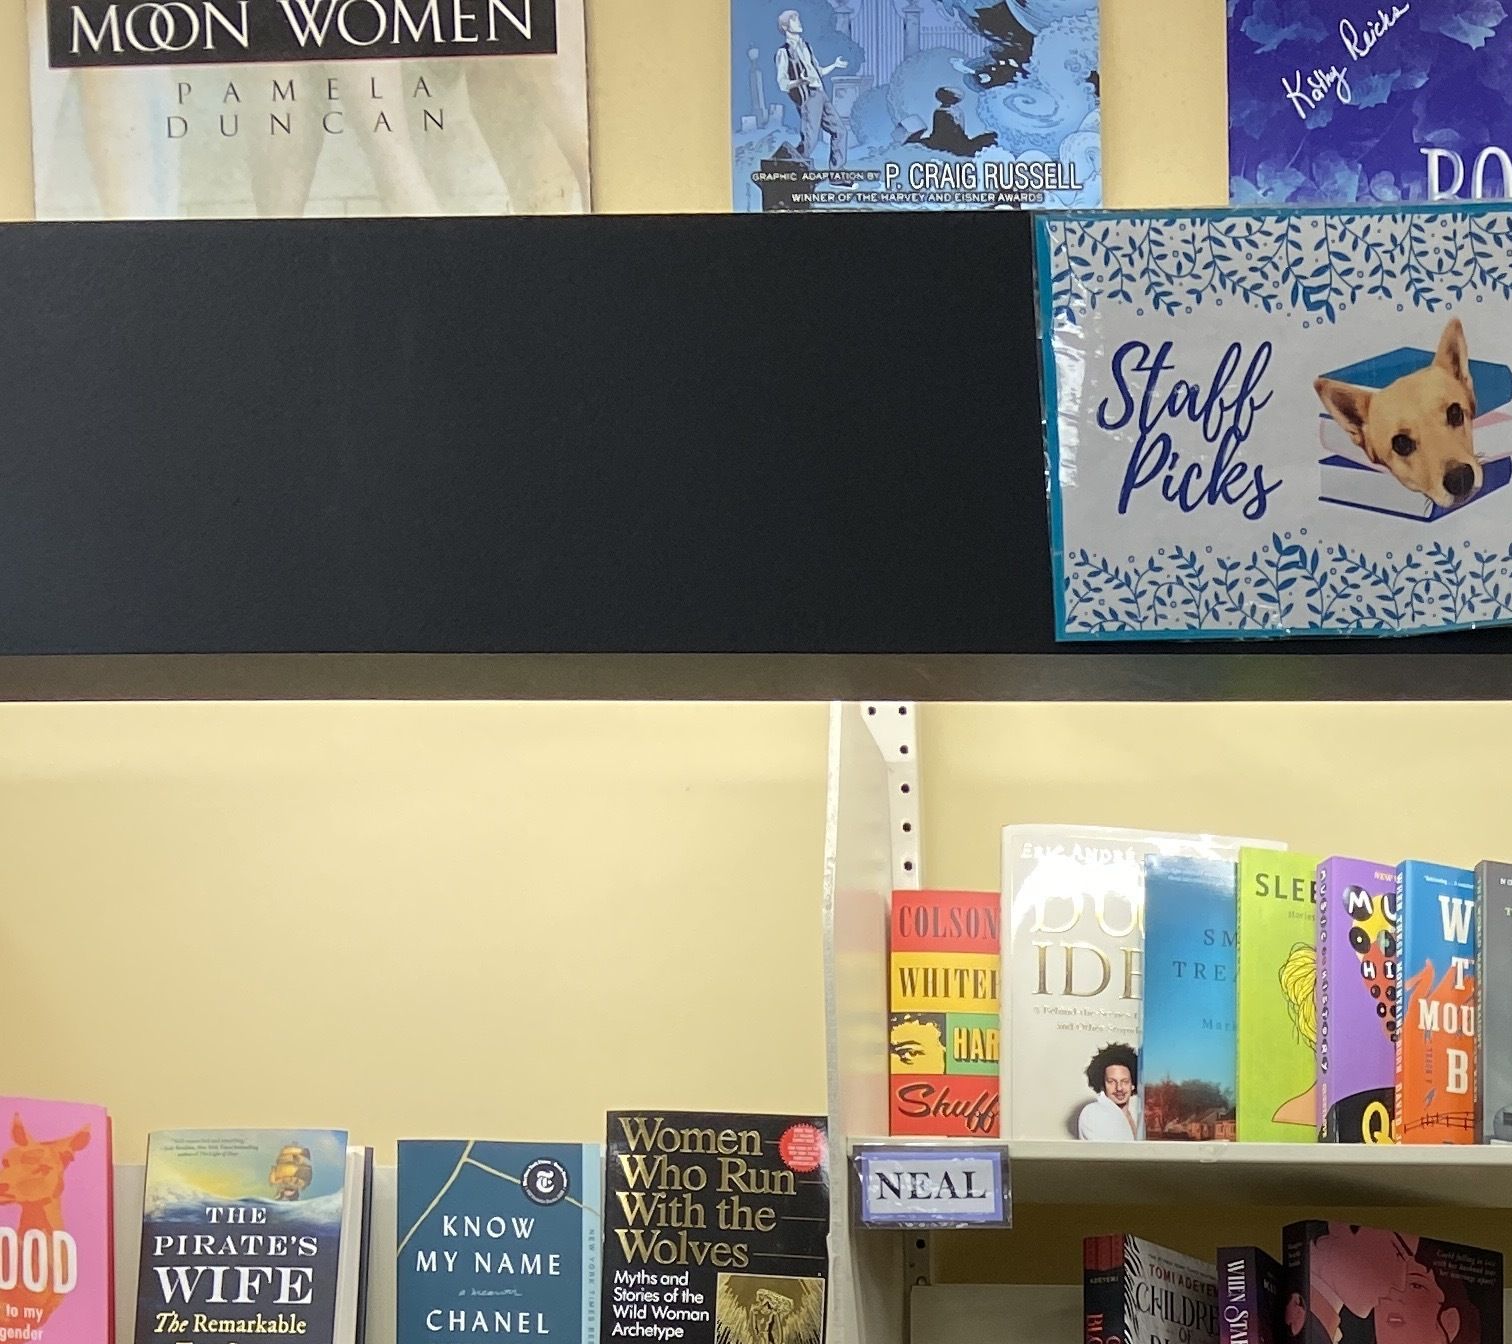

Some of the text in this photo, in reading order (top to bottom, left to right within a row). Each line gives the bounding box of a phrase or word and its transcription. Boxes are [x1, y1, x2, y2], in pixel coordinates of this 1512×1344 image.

[69, 0, 534, 54] MOON WOMEN
[177, 76, 431, 105] PAMELA
[167, 108, 445, 139] DUNCAN
[752, 162, 1083, 190] GRAPHIC ADAPTATION BY P. CRAIG RUSSELL
[792, 193, 1043, 202] WINNER OF THE HARVEY AND EISNER AWARDS
[1097, 340, 1273, 443] Staff
[1117, 426, 1283, 521] Picks
[618, 1117, 763, 1156] Women
[619, 1155, 796, 1195] Who Run
[875, 1170, 987, 1200] NEAL
[206, 1207, 267, 1224] THE
[616, 1192, 776, 1231] With the
[443, 1216, 536, 1239] KNOW
[153, 1235, 318, 1256] PIRATE'S
[614, 1229, 749, 1268] Wolves
[416, 1251, 560, 1275] MY NAME
[153, 1266, 313, 1304] WIFE
[426, 1310, 549, 1334] CHANEL
